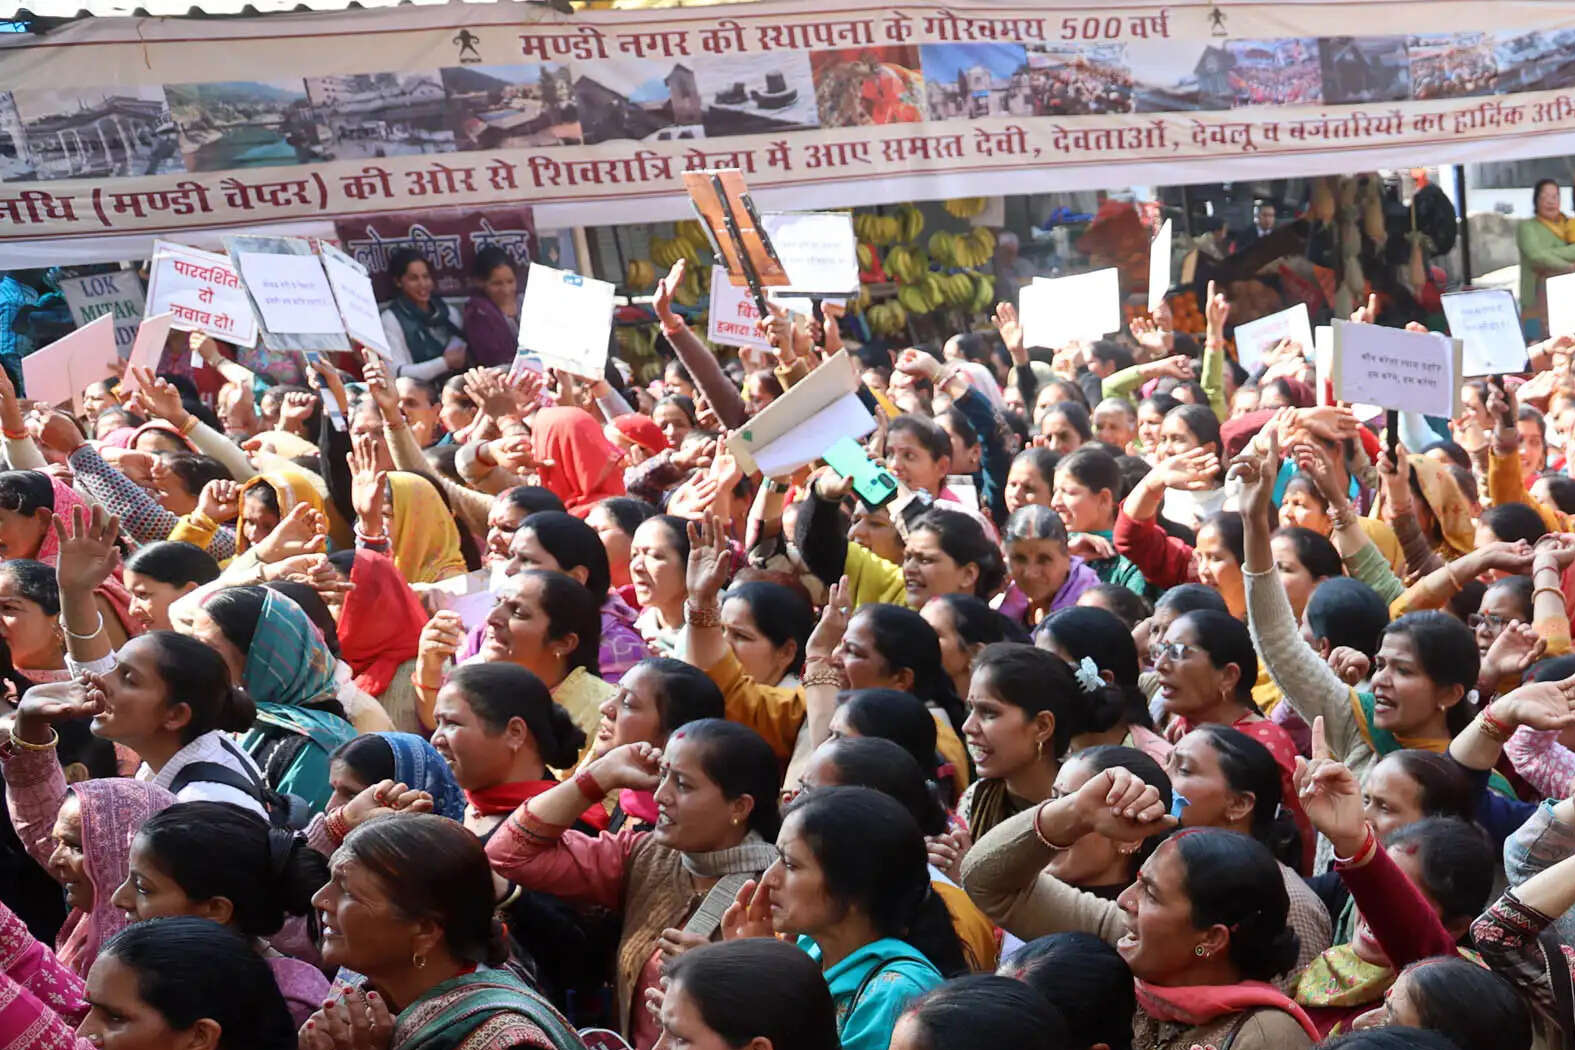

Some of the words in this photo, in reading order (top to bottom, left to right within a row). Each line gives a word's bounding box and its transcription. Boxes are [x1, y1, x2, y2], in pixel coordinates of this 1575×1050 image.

[519, 26, 610, 61] मण्डी
[616, 30, 691, 59] नगर
[699, 20, 748, 53] की
[756, 18, 875, 50] स्थापना
[883, 11, 913, 43] के
[1060, 17, 1122, 41] 500
[1129, 8, 1170, 39] वर्ष
[92, 180, 214, 226] (मण्डी
[220, 171, 328, 210] चैप्टर)
[339, 166, 393, 199] की
[405, 162, 478, 196] ओर
[486, 158, 518, 190] से
[528, 150, 674, 188] शिवरात्रि
[765, 140, 795, 170] में
[804, 140, 872, 168] आए
[881, 133, 965, 162] समस्त
[973, 126, 1042, 158] देवी,
[1263, 122, 1280, 143] व
[1412, 111, 1447, 133] का
[1453, 98, 1527, 134] हार्दिक
[350, 224, 462, 274] लोमित्र
[80, 275, 119, 298] LOK
[173, 258, 243, 290] पारदर्शित
[198, 287, 215, 305] दो
[213, 312, 235, 333] दो!
